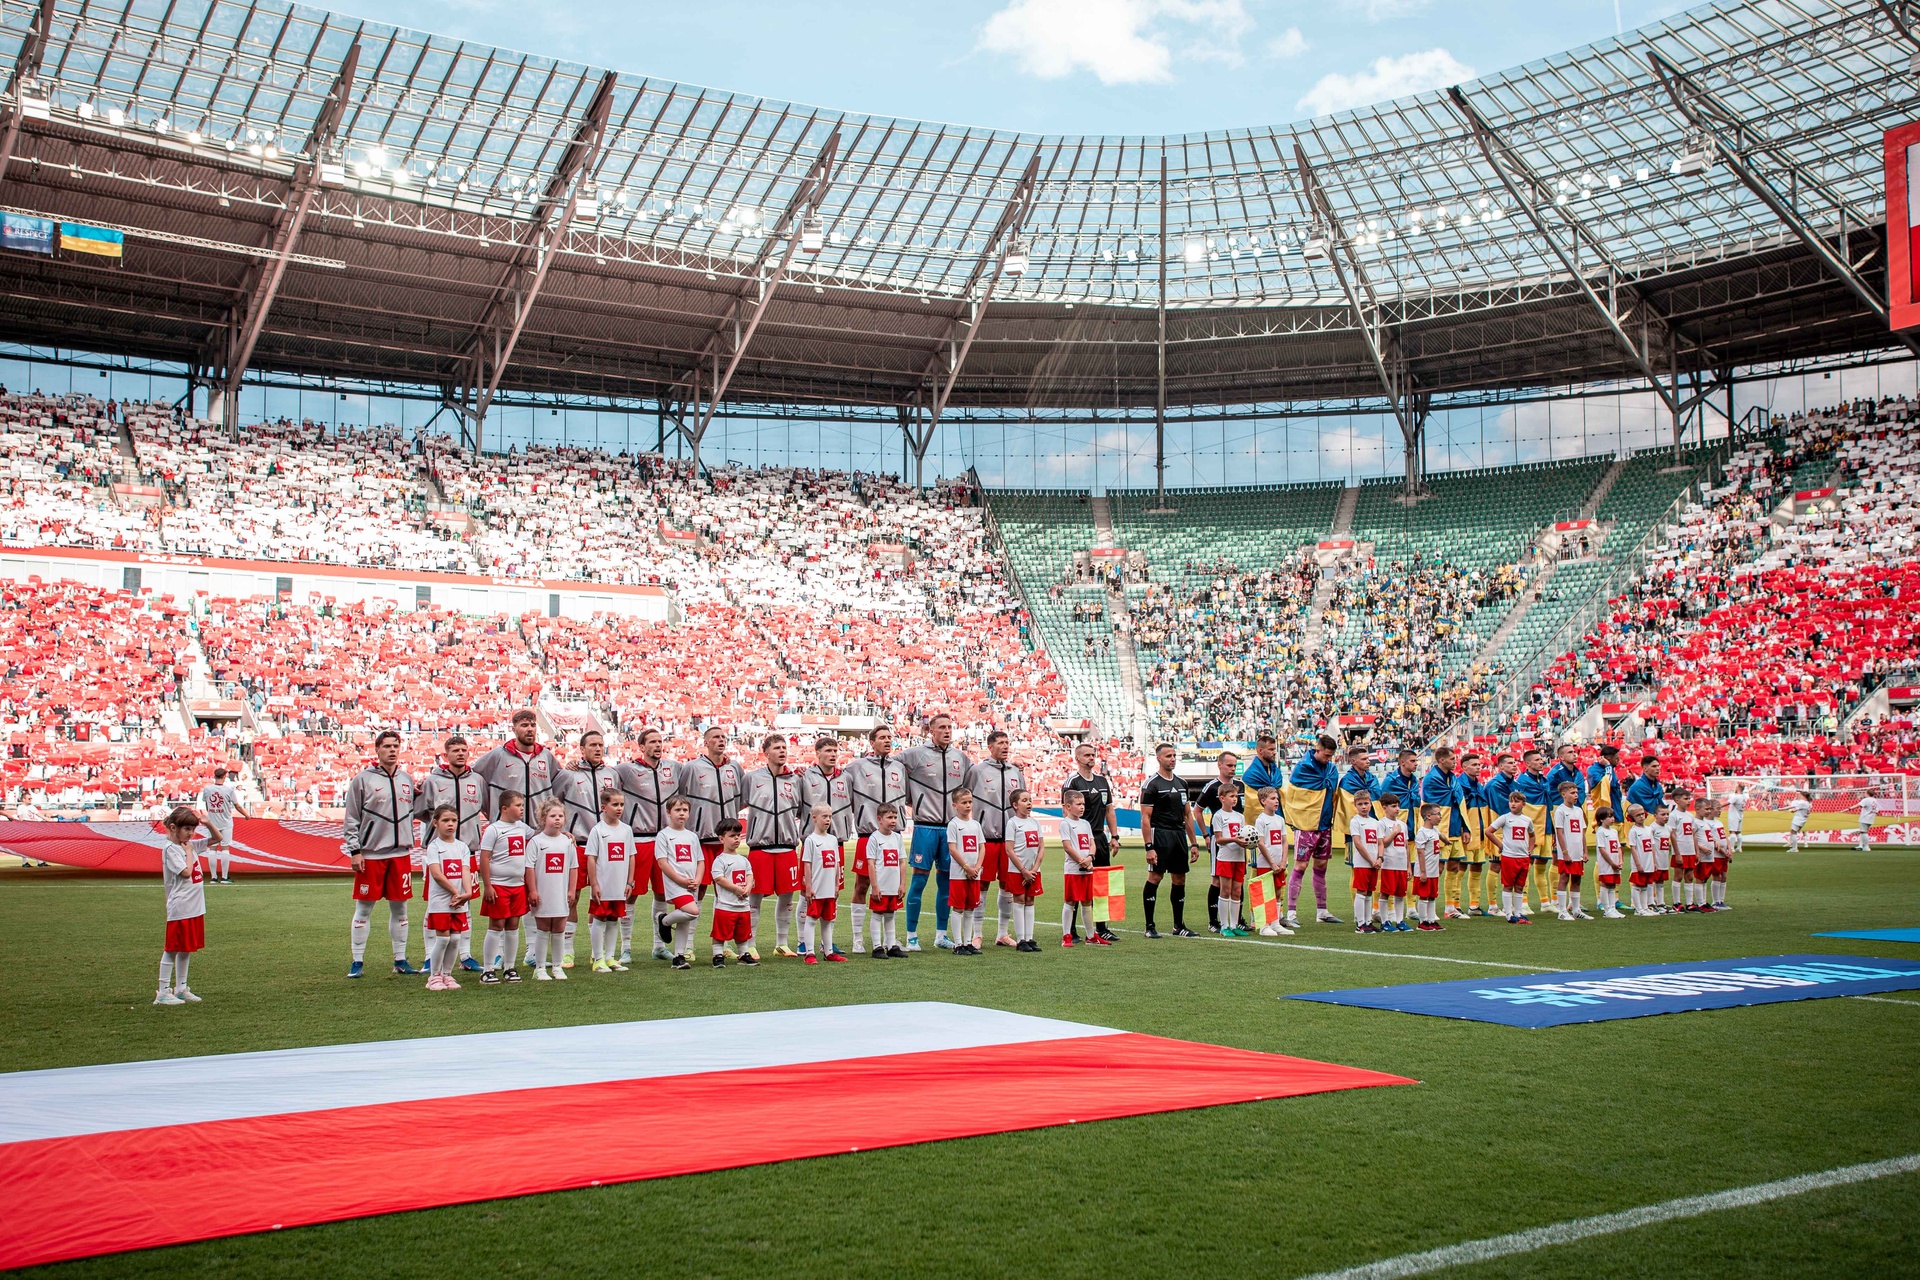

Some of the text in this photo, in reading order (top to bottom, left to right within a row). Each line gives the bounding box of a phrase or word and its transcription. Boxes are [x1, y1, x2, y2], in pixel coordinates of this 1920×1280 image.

[14, 229, 49, 239] RESPECT
[138, 554, 203, 566] POLSKA
[492, 577, 546, 588] POLSKA
[402, 872, 412, 888] 21
[1468, 962, 1920, 1008] #FOOTBALL
